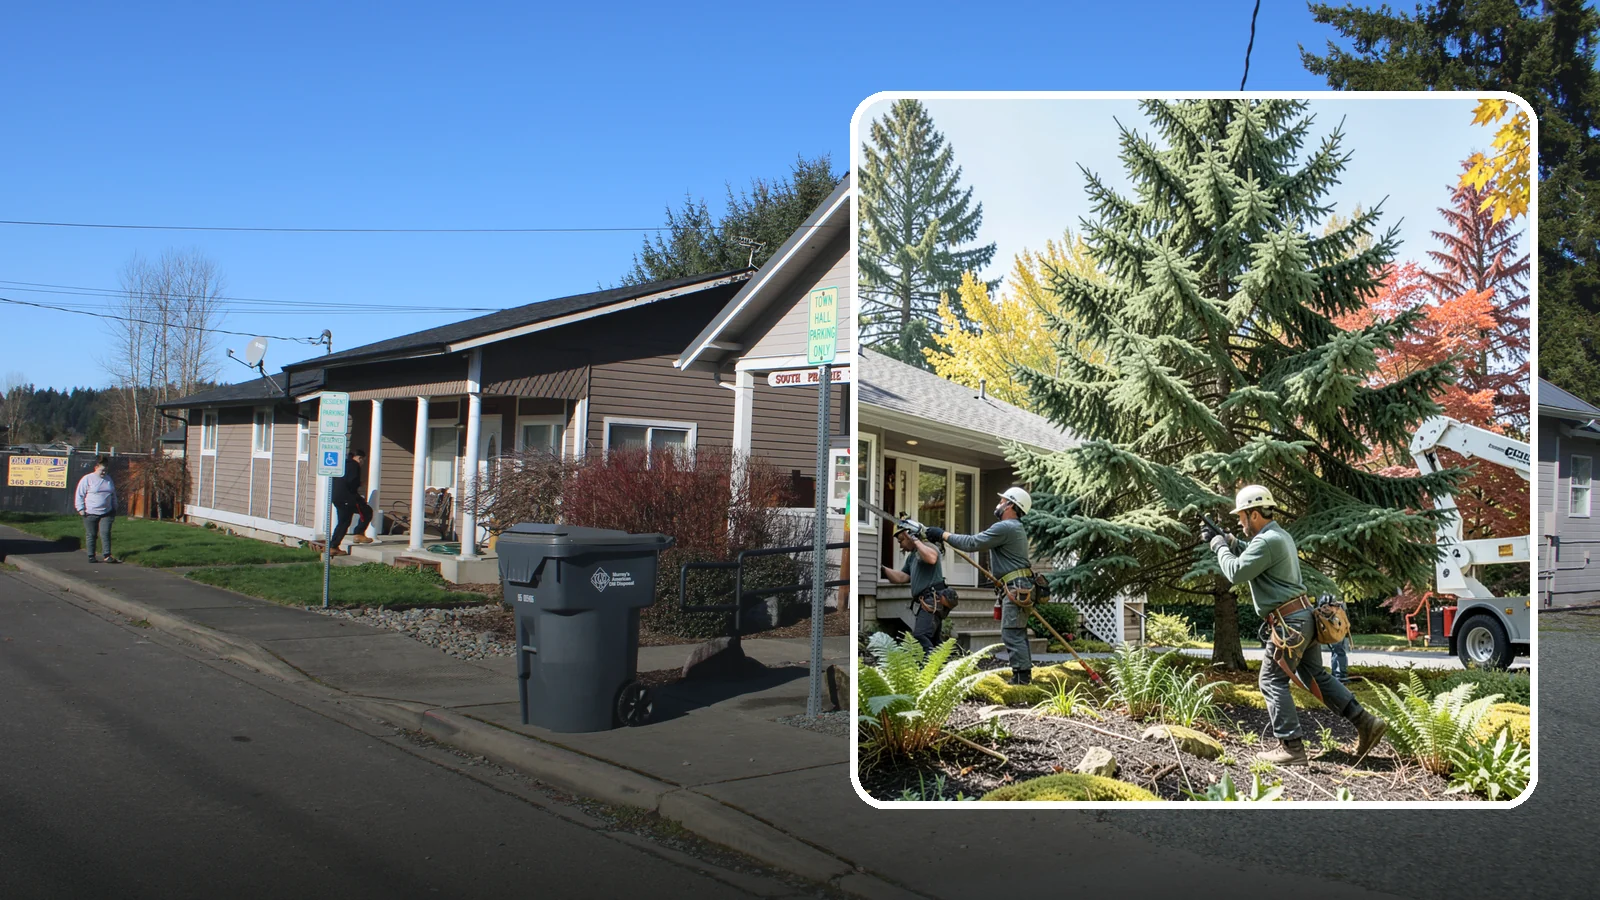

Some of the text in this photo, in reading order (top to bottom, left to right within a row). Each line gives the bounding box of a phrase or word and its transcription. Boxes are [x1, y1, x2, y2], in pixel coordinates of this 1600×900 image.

[815, 295, 833, 308] TOWN
[814, 311, 831, 324] HALL
[809, 326, 836, 340] PARKING
[813, 344, 831, 357] ONLY
[775, 373, 801, 384] SOUTH
